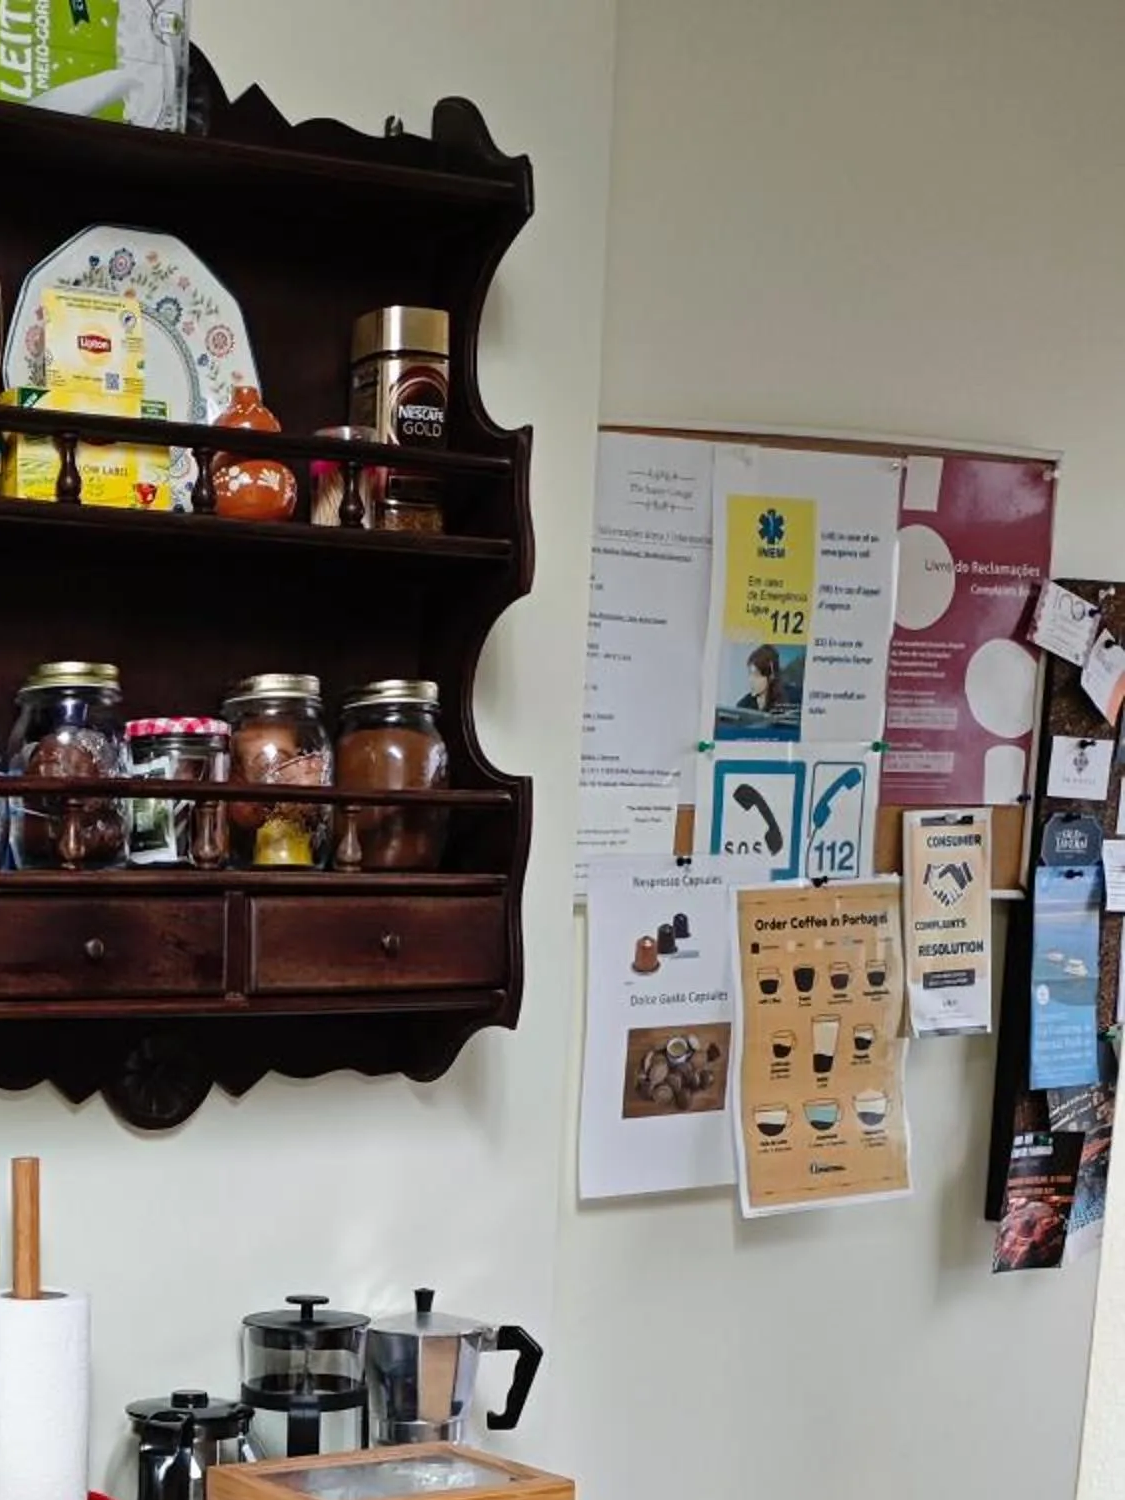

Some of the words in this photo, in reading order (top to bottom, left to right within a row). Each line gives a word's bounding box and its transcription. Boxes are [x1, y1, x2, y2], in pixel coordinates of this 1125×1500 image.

[35, 0, 51, 89] MEIO-GOR
[80, 337, 111, 350] Lipton
[402, 421, 442, 437] GOLD
[955, 561, 969, 574] do
[972, 561, 1040, 579] Reclamações
[771, 609, 805, 635] 112
[926, 834, 982, 849] CONSUMER
[814, 839, 855, 873] 112
[632, 876, 679, 890] Nespresso
[682, 875, 723, 889] Capsules
[754, 917, 787, 932] Order
[790, 915, 828, 930] Coffee
[830, 914, 840, 927] in
[842, 911, 888, 928] Portugal
[918, 940, 984, 958] RESOLUTION
[630, 994, 657, 1008] Dolce
[658, 993, 686, 1005] Gusto
[688, 990, 729, 1004] Capsules
